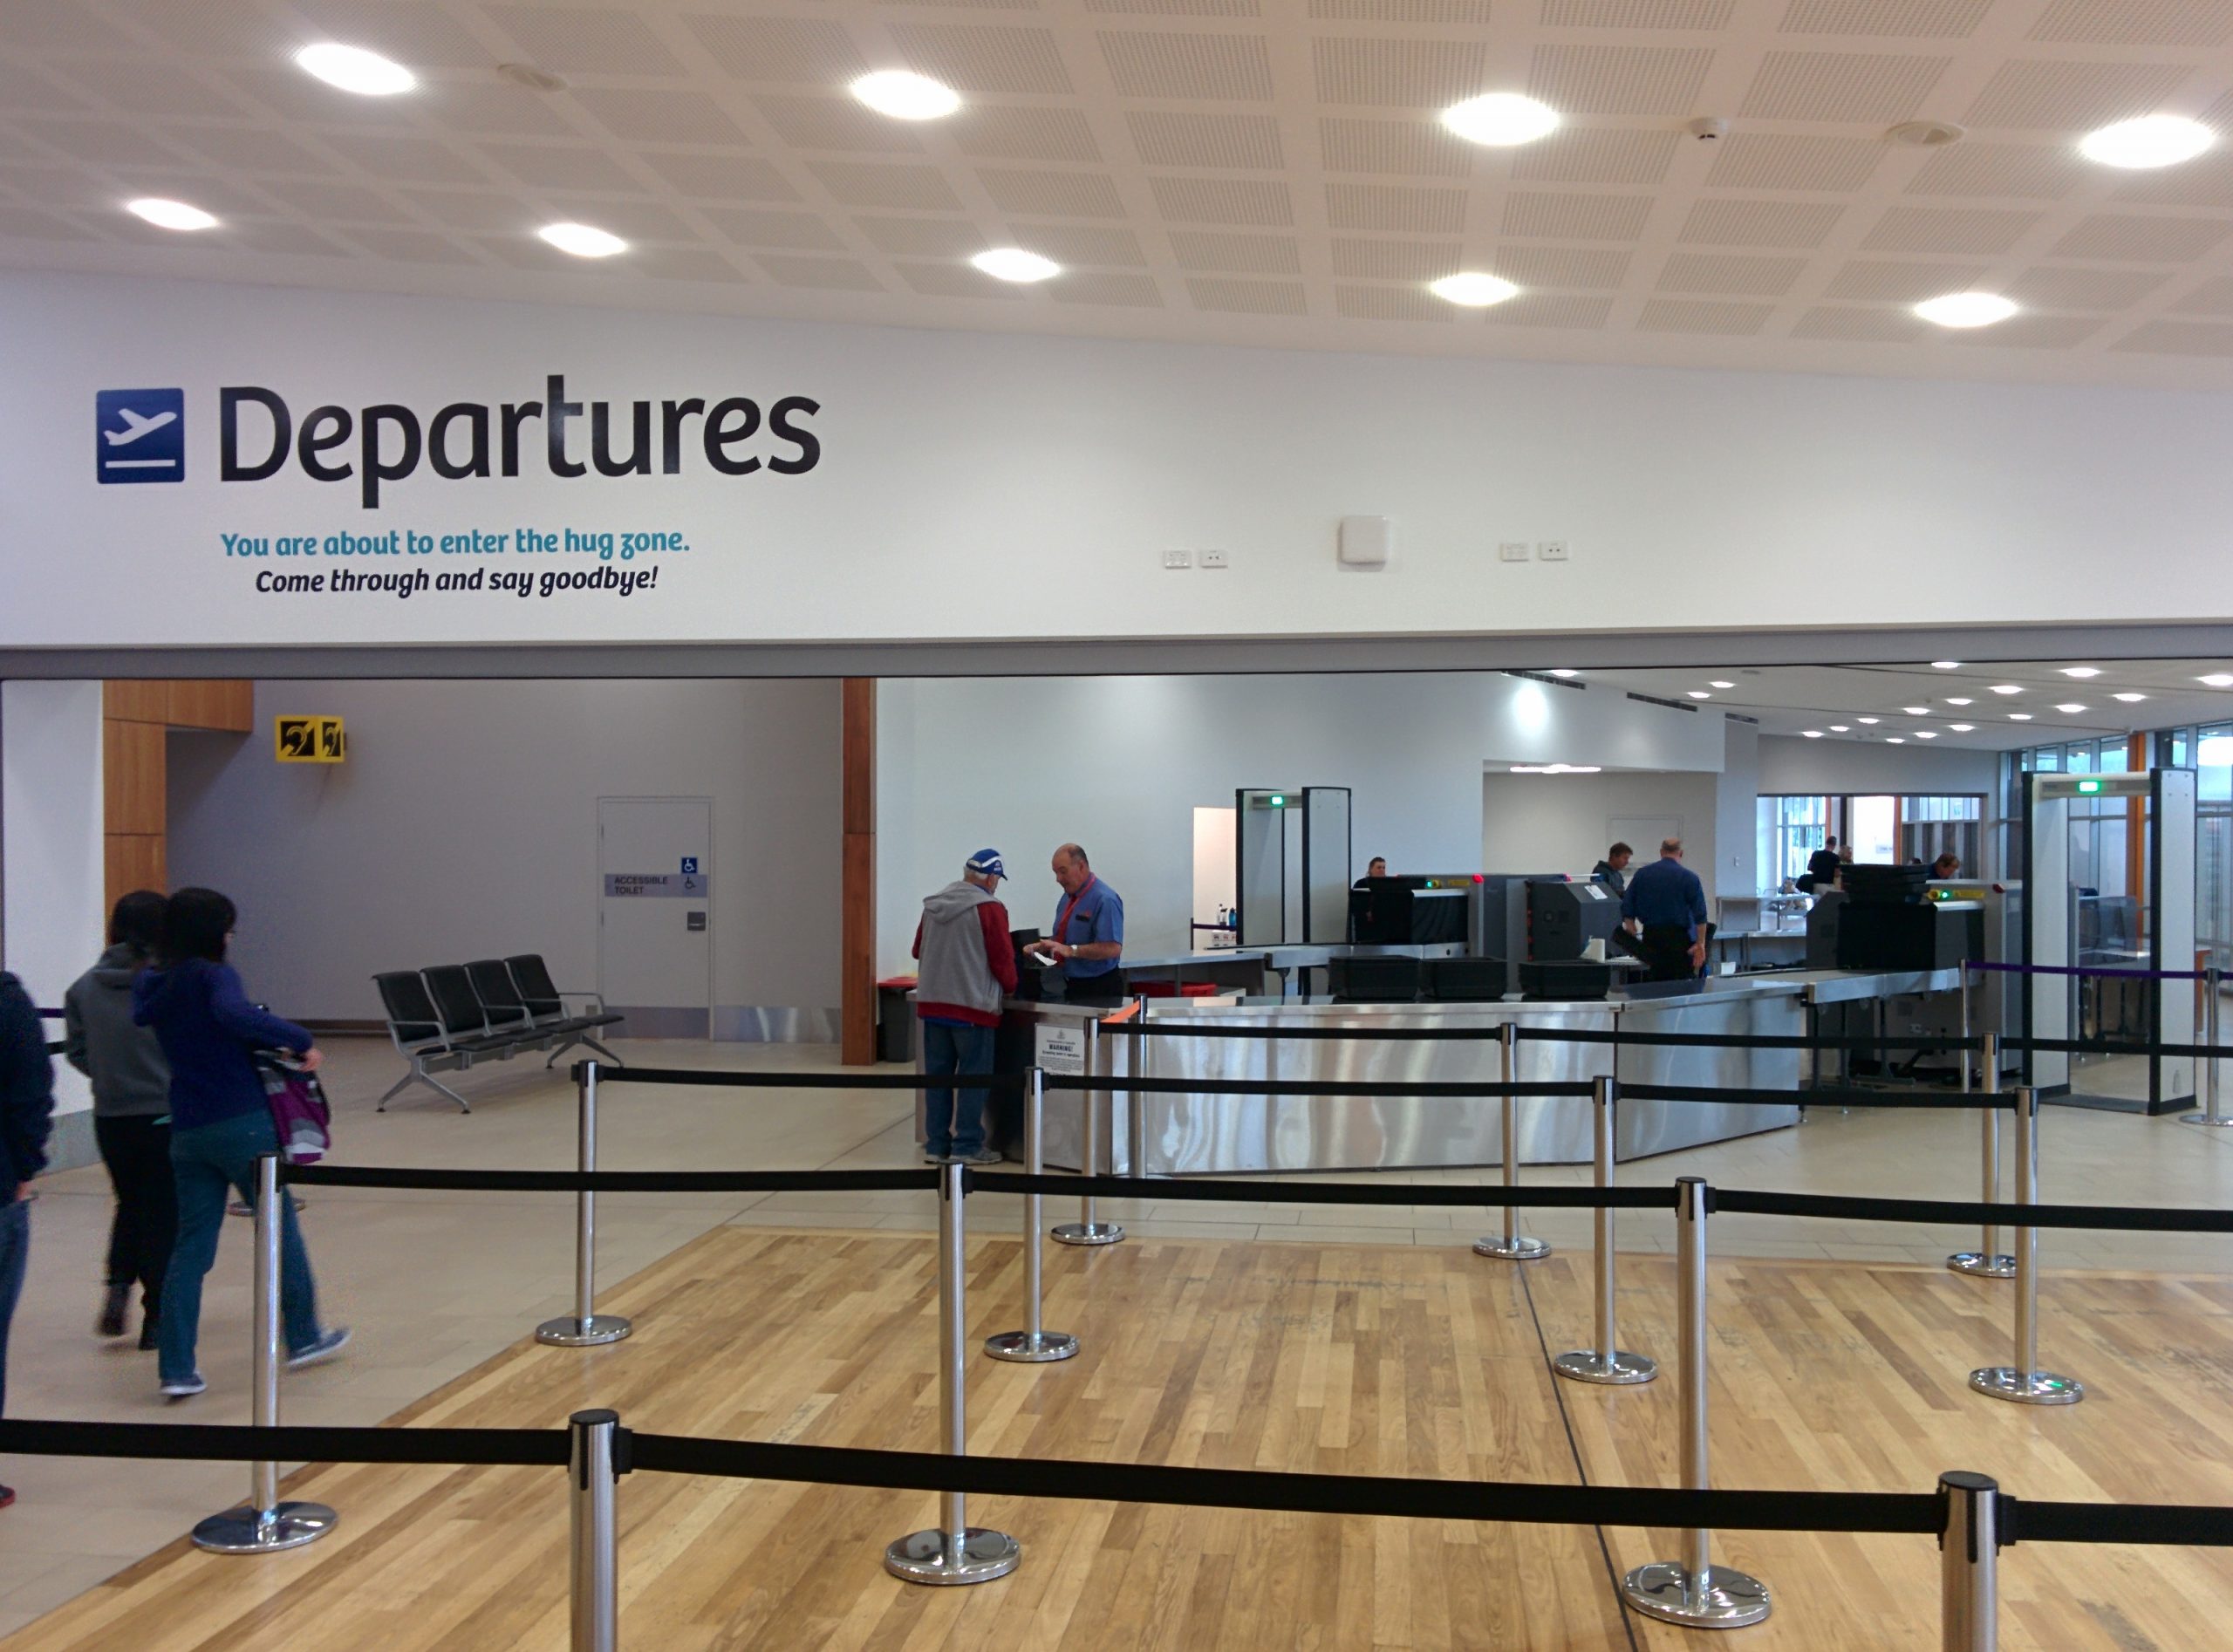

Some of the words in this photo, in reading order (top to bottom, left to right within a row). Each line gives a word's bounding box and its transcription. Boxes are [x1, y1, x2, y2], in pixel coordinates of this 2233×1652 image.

[220, 374, 822, 509] Departures
[220, 533, 270, 557] You
[276, 537, 318, 556] are
[324, 530, 400, 556] about
[407, 529, 434, 555] to
[440, 529, 509, 555] enter
[516, 528, 559, 553] the
[565, 528, 614, 561] hug
[620, 531, 690, 560] zone.
[256, 570, 325, 593] Come
[331, 568, 430, 599] through
[435, 567, 484, 590] and
[488, 572, 534, 598] say
[539, 565, 659, 597] goodbye!
